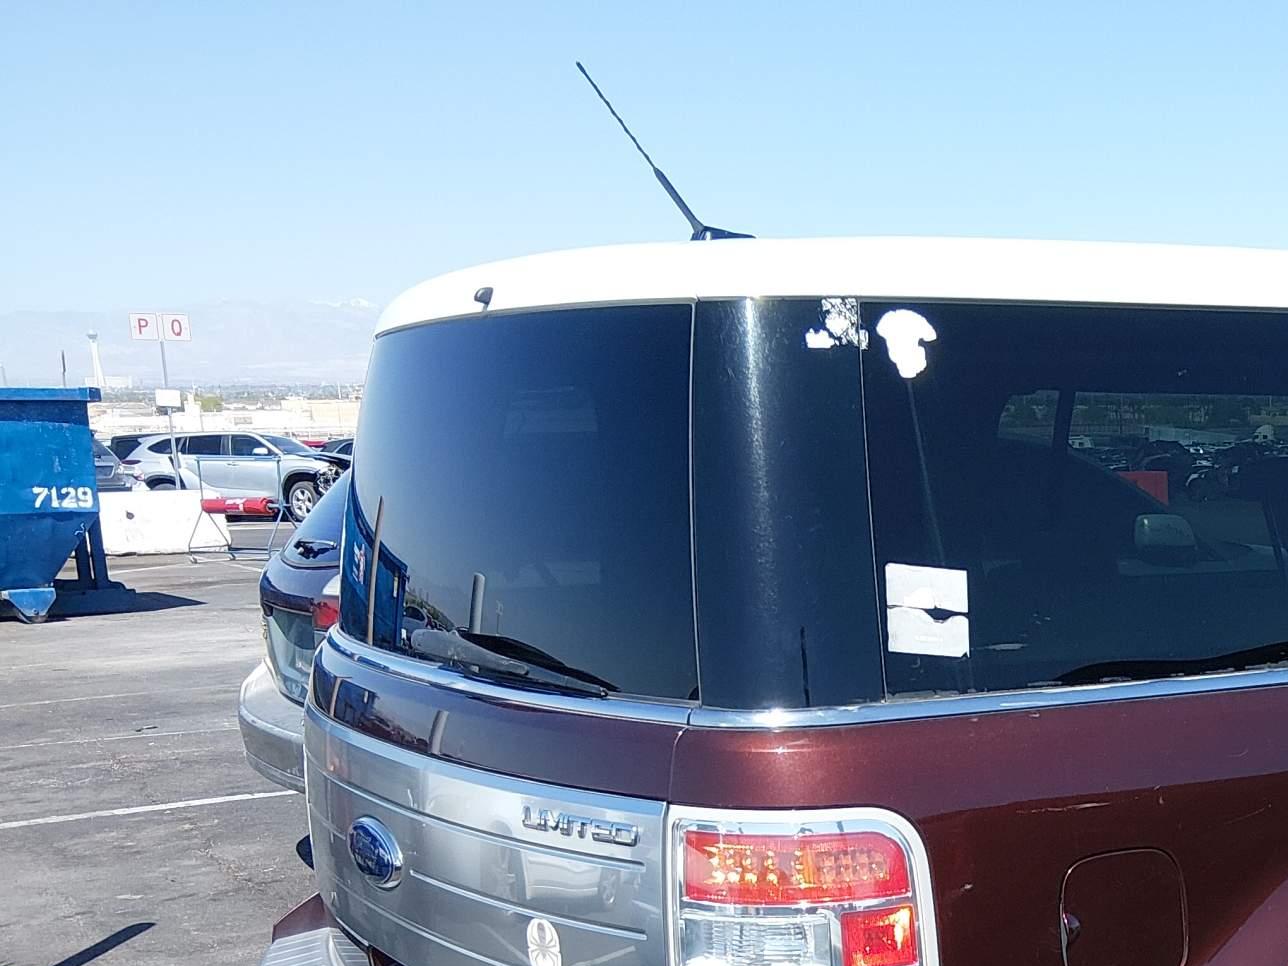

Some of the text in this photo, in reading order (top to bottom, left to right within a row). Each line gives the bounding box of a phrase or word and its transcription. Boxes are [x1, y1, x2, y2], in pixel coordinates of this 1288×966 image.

[137, 317, 149, 335] P
[31, 486, 94, 509] 7129
[522, 805, 640, 847] LIMITED
